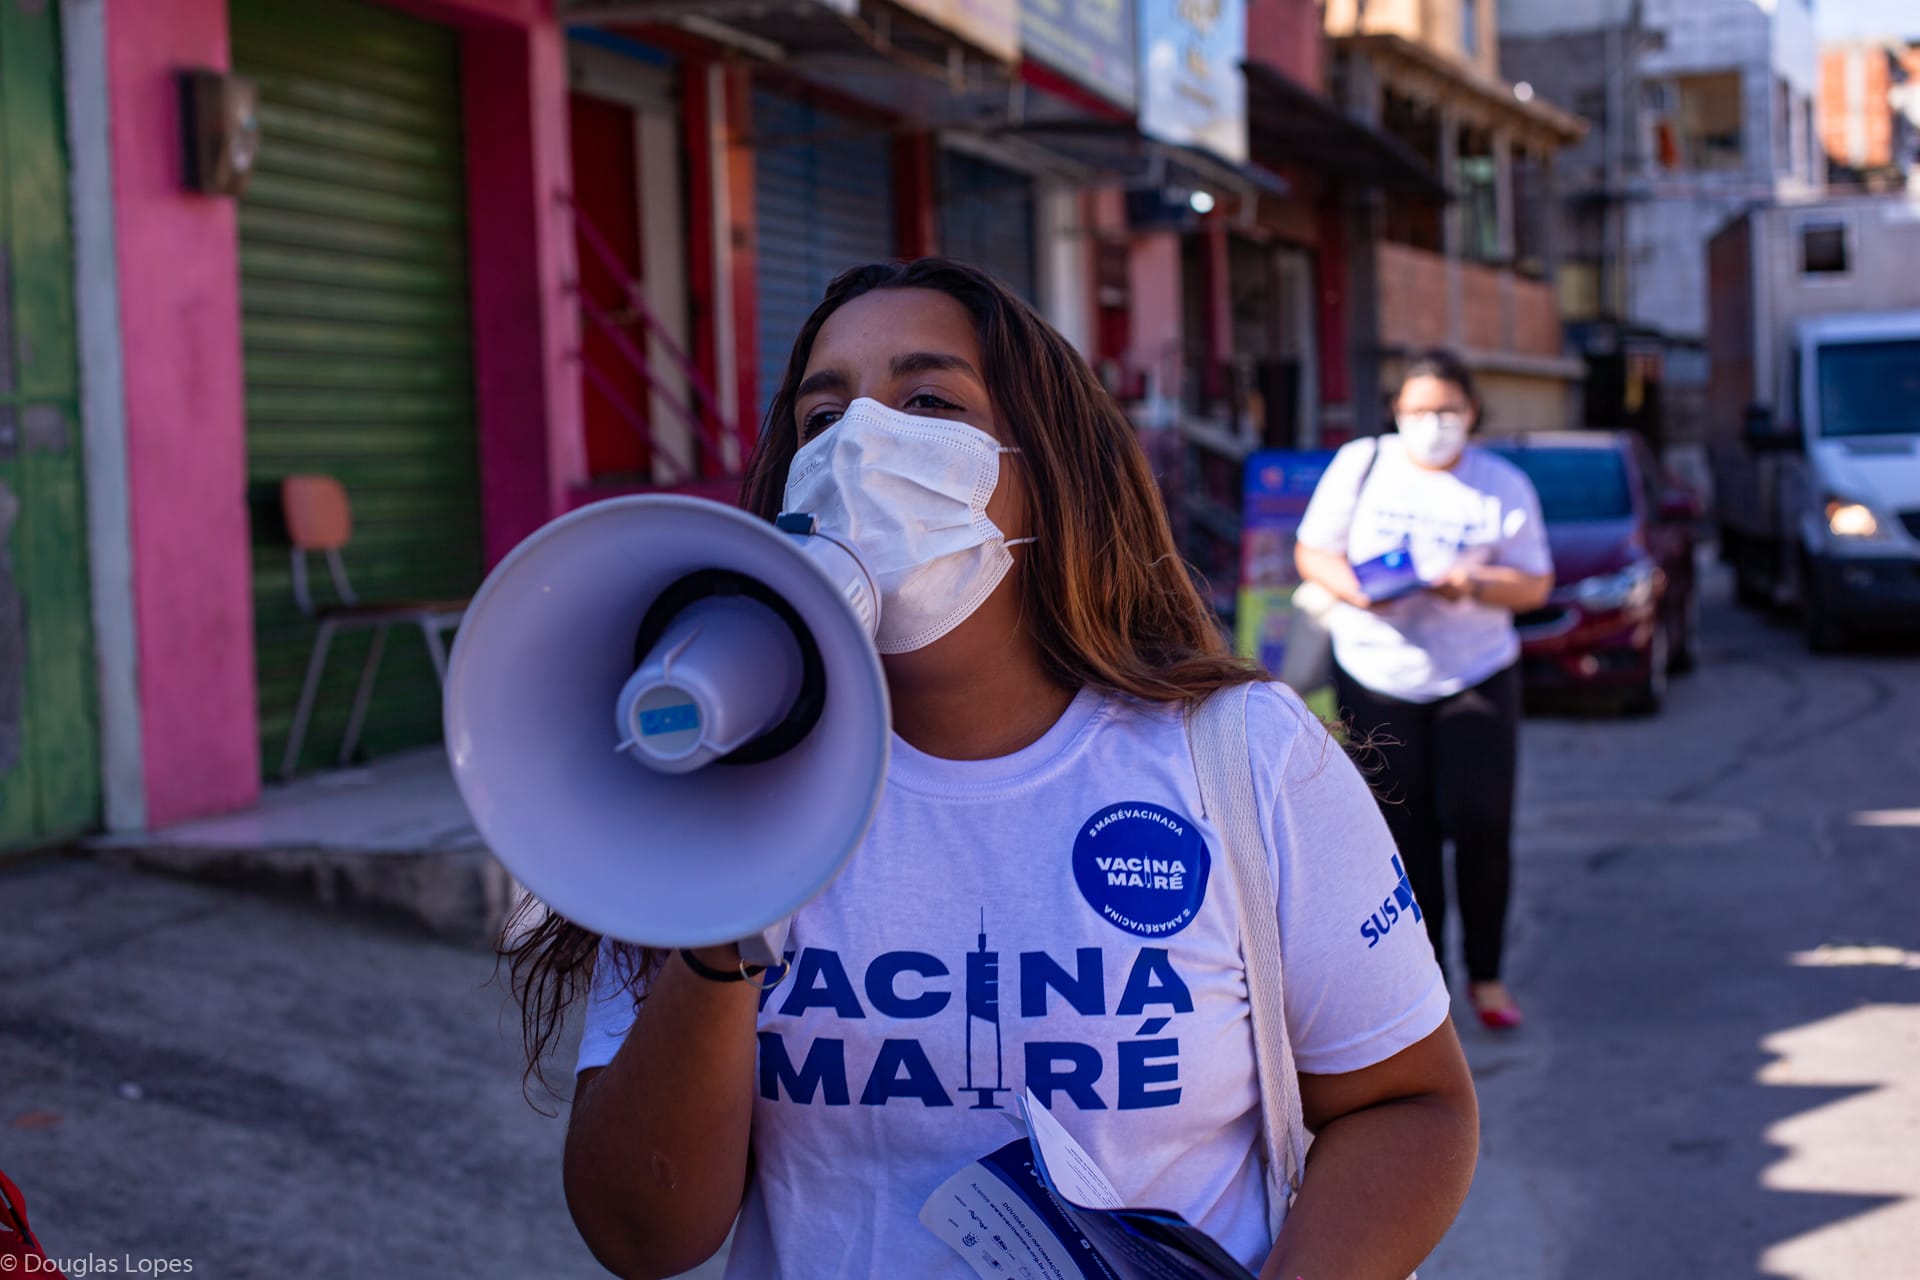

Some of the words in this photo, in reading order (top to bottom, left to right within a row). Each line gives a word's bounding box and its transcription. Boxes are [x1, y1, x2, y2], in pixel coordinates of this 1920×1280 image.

[1088, 808, 1183, 838] #MARÉVACINADA
[1095, 856, 1187, 874] VACINA
[1107, 872, 1184, 890] MARÉ
[1360, 896, 1399, 949] SUS
[757, 1017, 1183, 1110] MARÉ
